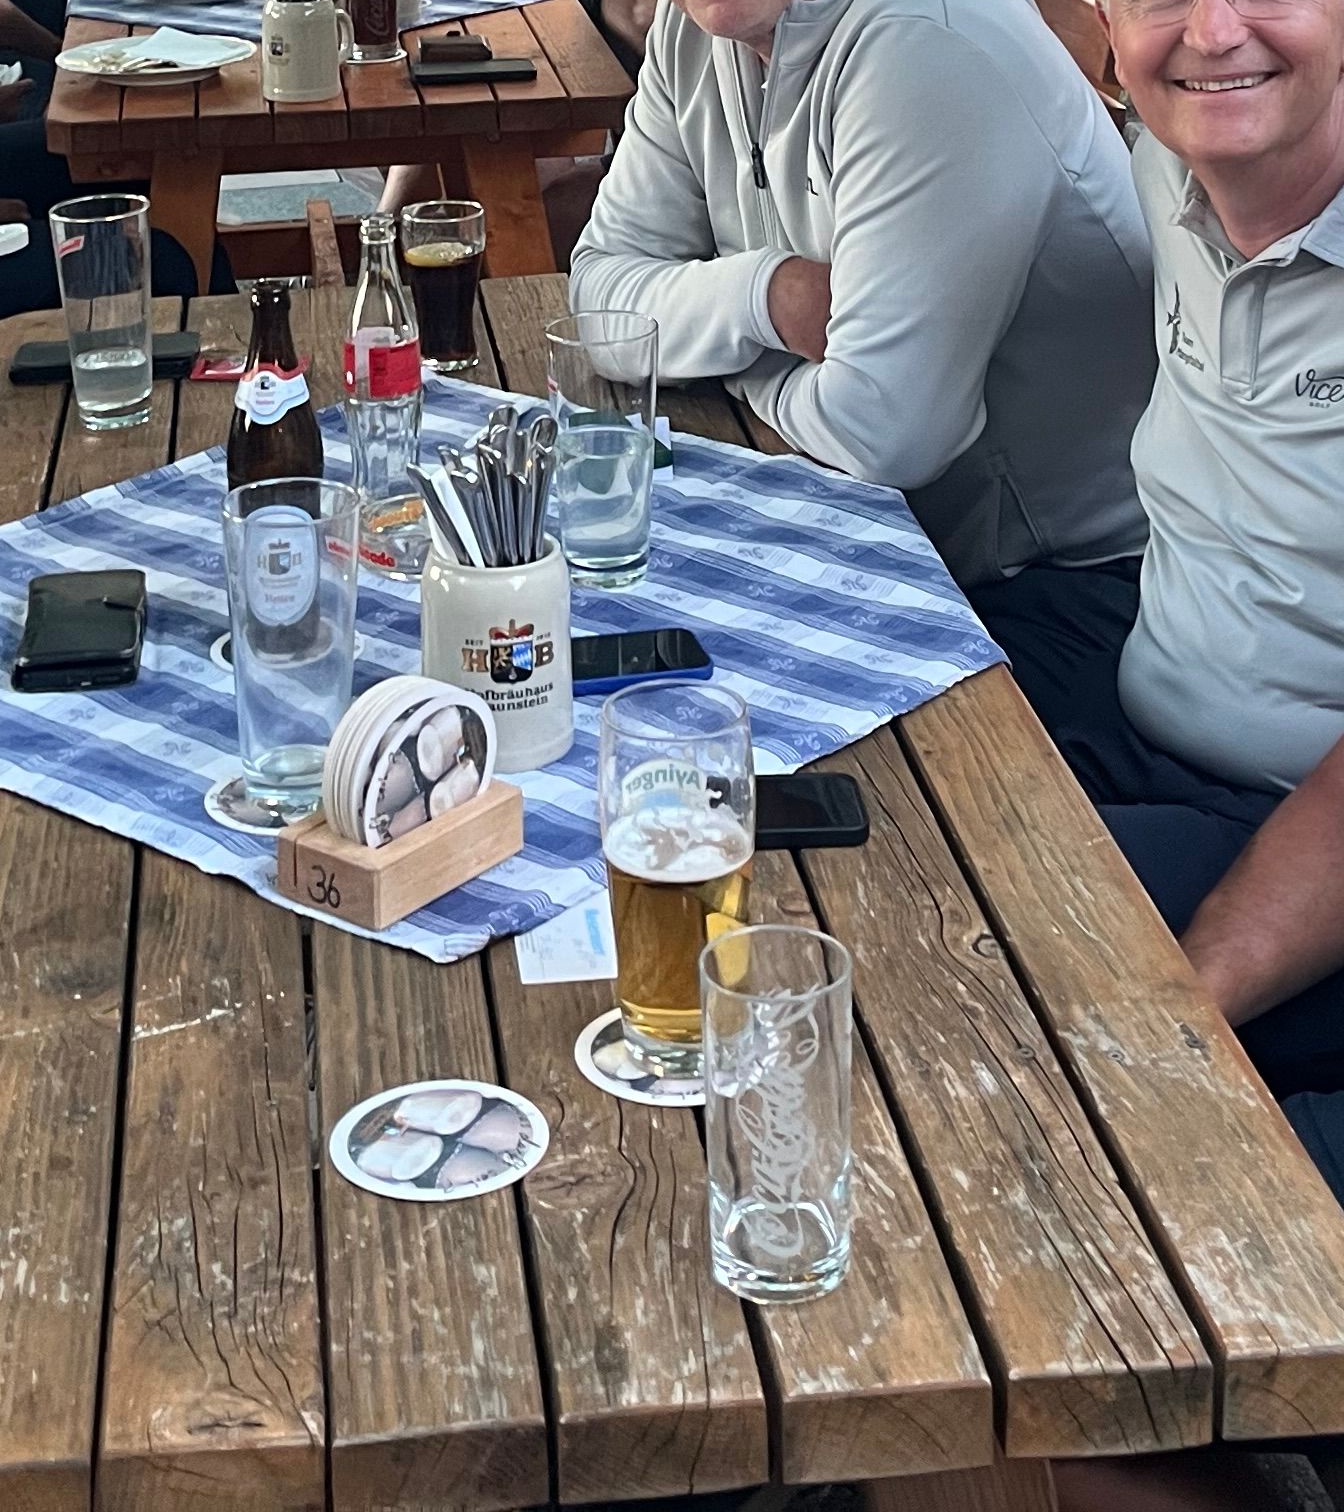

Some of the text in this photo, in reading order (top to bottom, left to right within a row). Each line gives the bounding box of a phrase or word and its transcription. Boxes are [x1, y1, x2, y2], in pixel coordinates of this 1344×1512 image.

[461, 640, 555, 673] H B
[307, 864, 341, 909] 36
